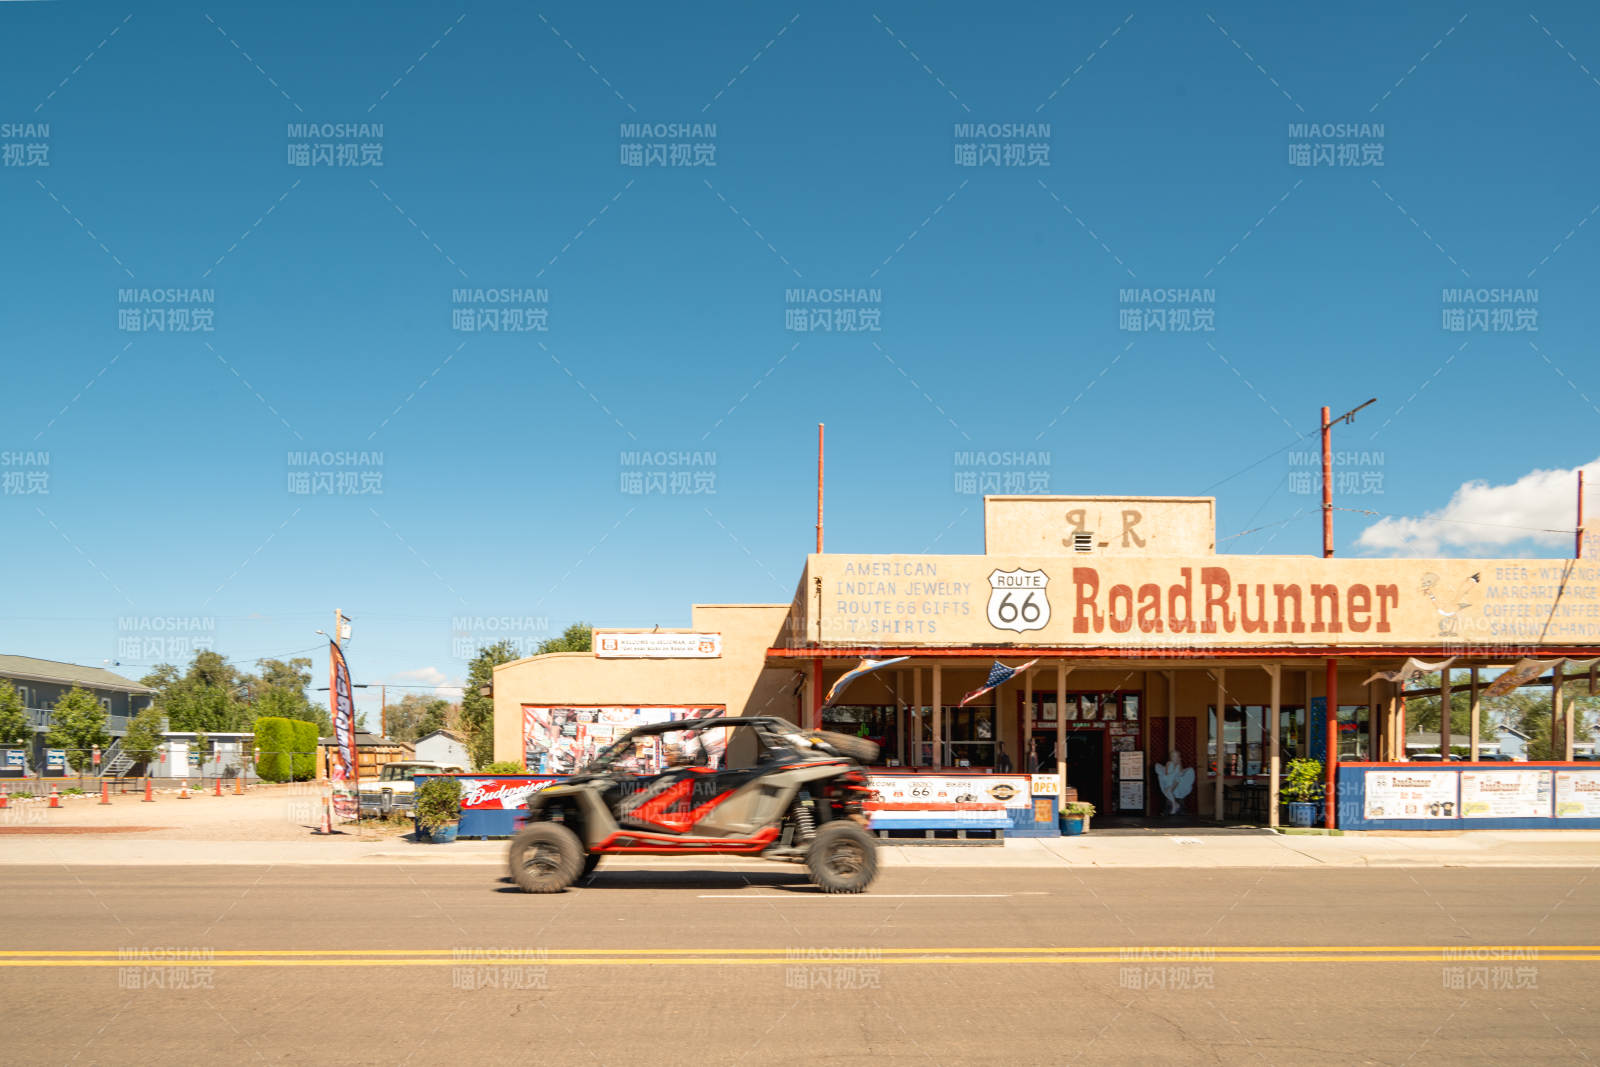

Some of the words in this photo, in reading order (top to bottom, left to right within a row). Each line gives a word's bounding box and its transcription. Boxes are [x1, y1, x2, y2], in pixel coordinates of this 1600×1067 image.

[845, 562, 937, 577] AMERICAN
[836, 581, 897, 596] INDIAN
[904, 582, 971, 597] JEWELRY
[998, 575, 1041, 588] ROUTE
[836, 600, 893, 615] ROUTE
[896, 601, 916, 615] 66
[922, 601, 971, 616] GIFTS
[999, 591, 1041, 624] 66
[1072, 566, 1399, 635] RoadRunner
[1484, 603, 1531, 617] COFFEE
[466, 780, 553, 807] Budweiser
[912, 787, 930, 797] 66
[1033, 782, 1058, 793] OPEN
